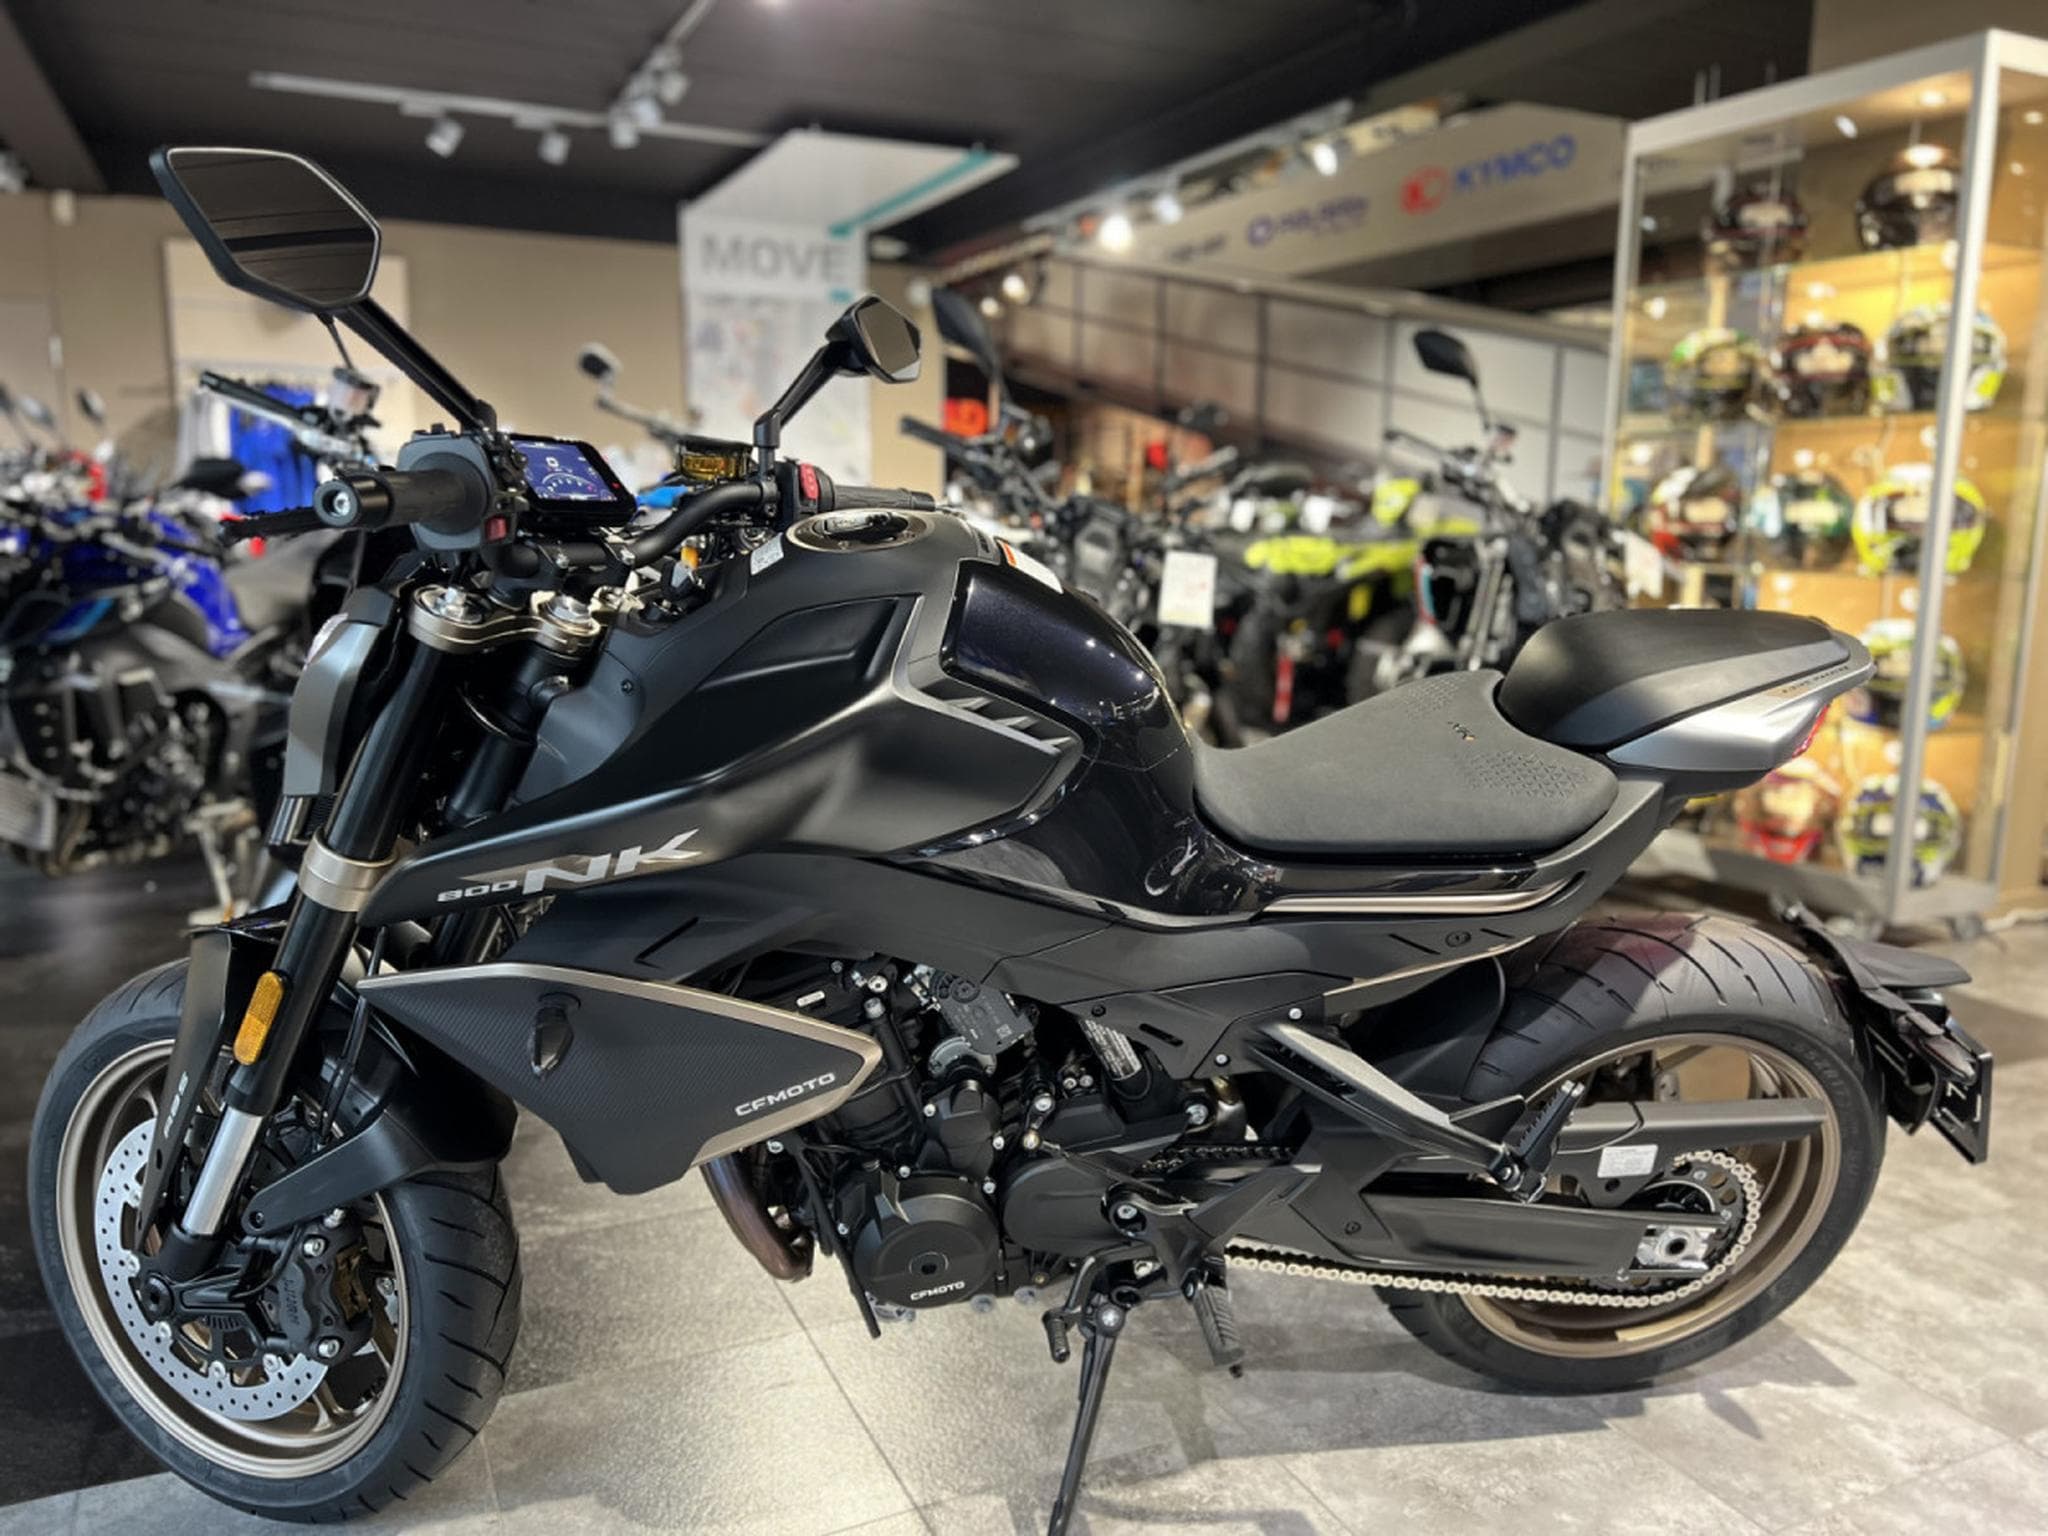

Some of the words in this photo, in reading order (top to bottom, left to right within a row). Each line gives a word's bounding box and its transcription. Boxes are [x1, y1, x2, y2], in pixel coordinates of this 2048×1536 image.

[1454, 133, 1577, 191] KYMCO
[701, 234, 848, 283] MOVE
[437, 879, 518, 902] 800
[522, 828, 702, 895] NK
[734, 1072, 836, 1117] CFMOTO
[910, 1280, 966, 1301] CFMOTO
